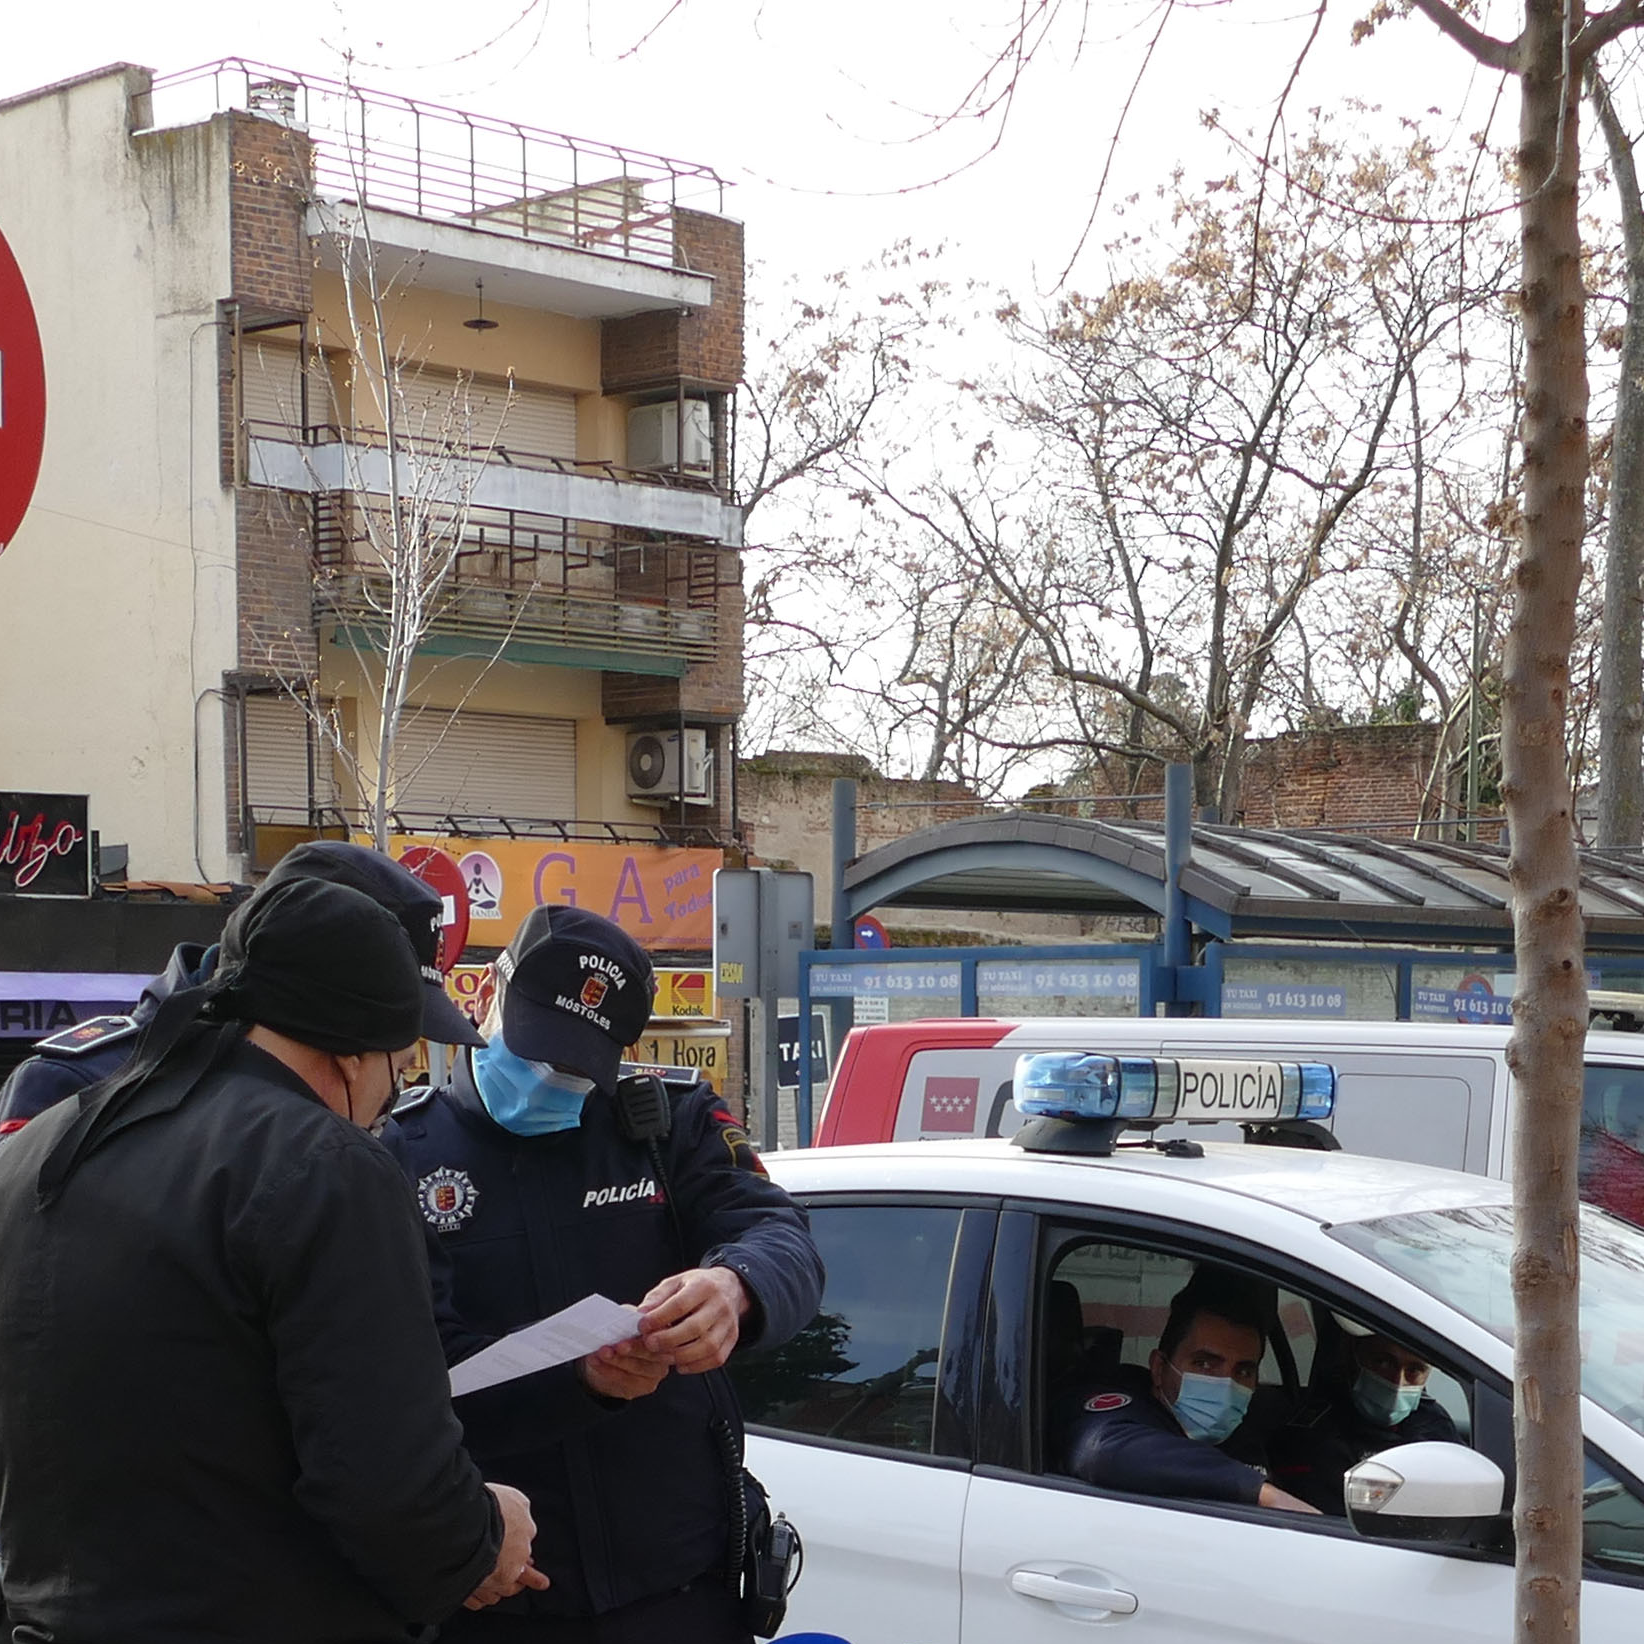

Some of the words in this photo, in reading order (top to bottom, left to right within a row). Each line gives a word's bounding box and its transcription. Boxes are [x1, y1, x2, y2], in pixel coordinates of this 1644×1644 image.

[663, 864, 700, 896] para
[816, 973, 828, 982] TU
[830, 973, 852, 982] TAXI
[864, 975, 881, 989] 91
[886, 974, 913, 990] 613
[918, 975, 936, 988] 10
[940, 974, 958, 988] 08
[983, 971, 996, 981] TU
[999, 971, 1022, 980] TAXI
[1035, 974, 1054, 989] 91
[1060, 973, 1088, 988] 613
[1094, 974, 1112, 987] 10
[1117, 973, 1137, 987] 08
[1226, 989, 1238, 999] TU
[1240, 989, 1258, 999] TAXI
[1267, 992, 1282, 1007] 91
[1285, 992, 1307, 1009] 613
[1310, 993, 1324, 1008] 10
[1327, 993, 1342, 1008] 08
[1418, 991, 1429, 1001] TU
[1430, 991, 1446, 1002] TAXI
[555, 994, 612, 1030] MÓSTOLES
[672, 1004, 704, 1016] Kodak
[1453, 998, 1467, 1013] 91
[1469, 999, 1489, 1015] 613
[1492, 1000, 1505, 1015] 10
[673, 1039, 716, 1068] Hora
[1181, 1066, 1278, 1110] POLICÍA
[582, 1177, 656, 1208] POLICÍA
